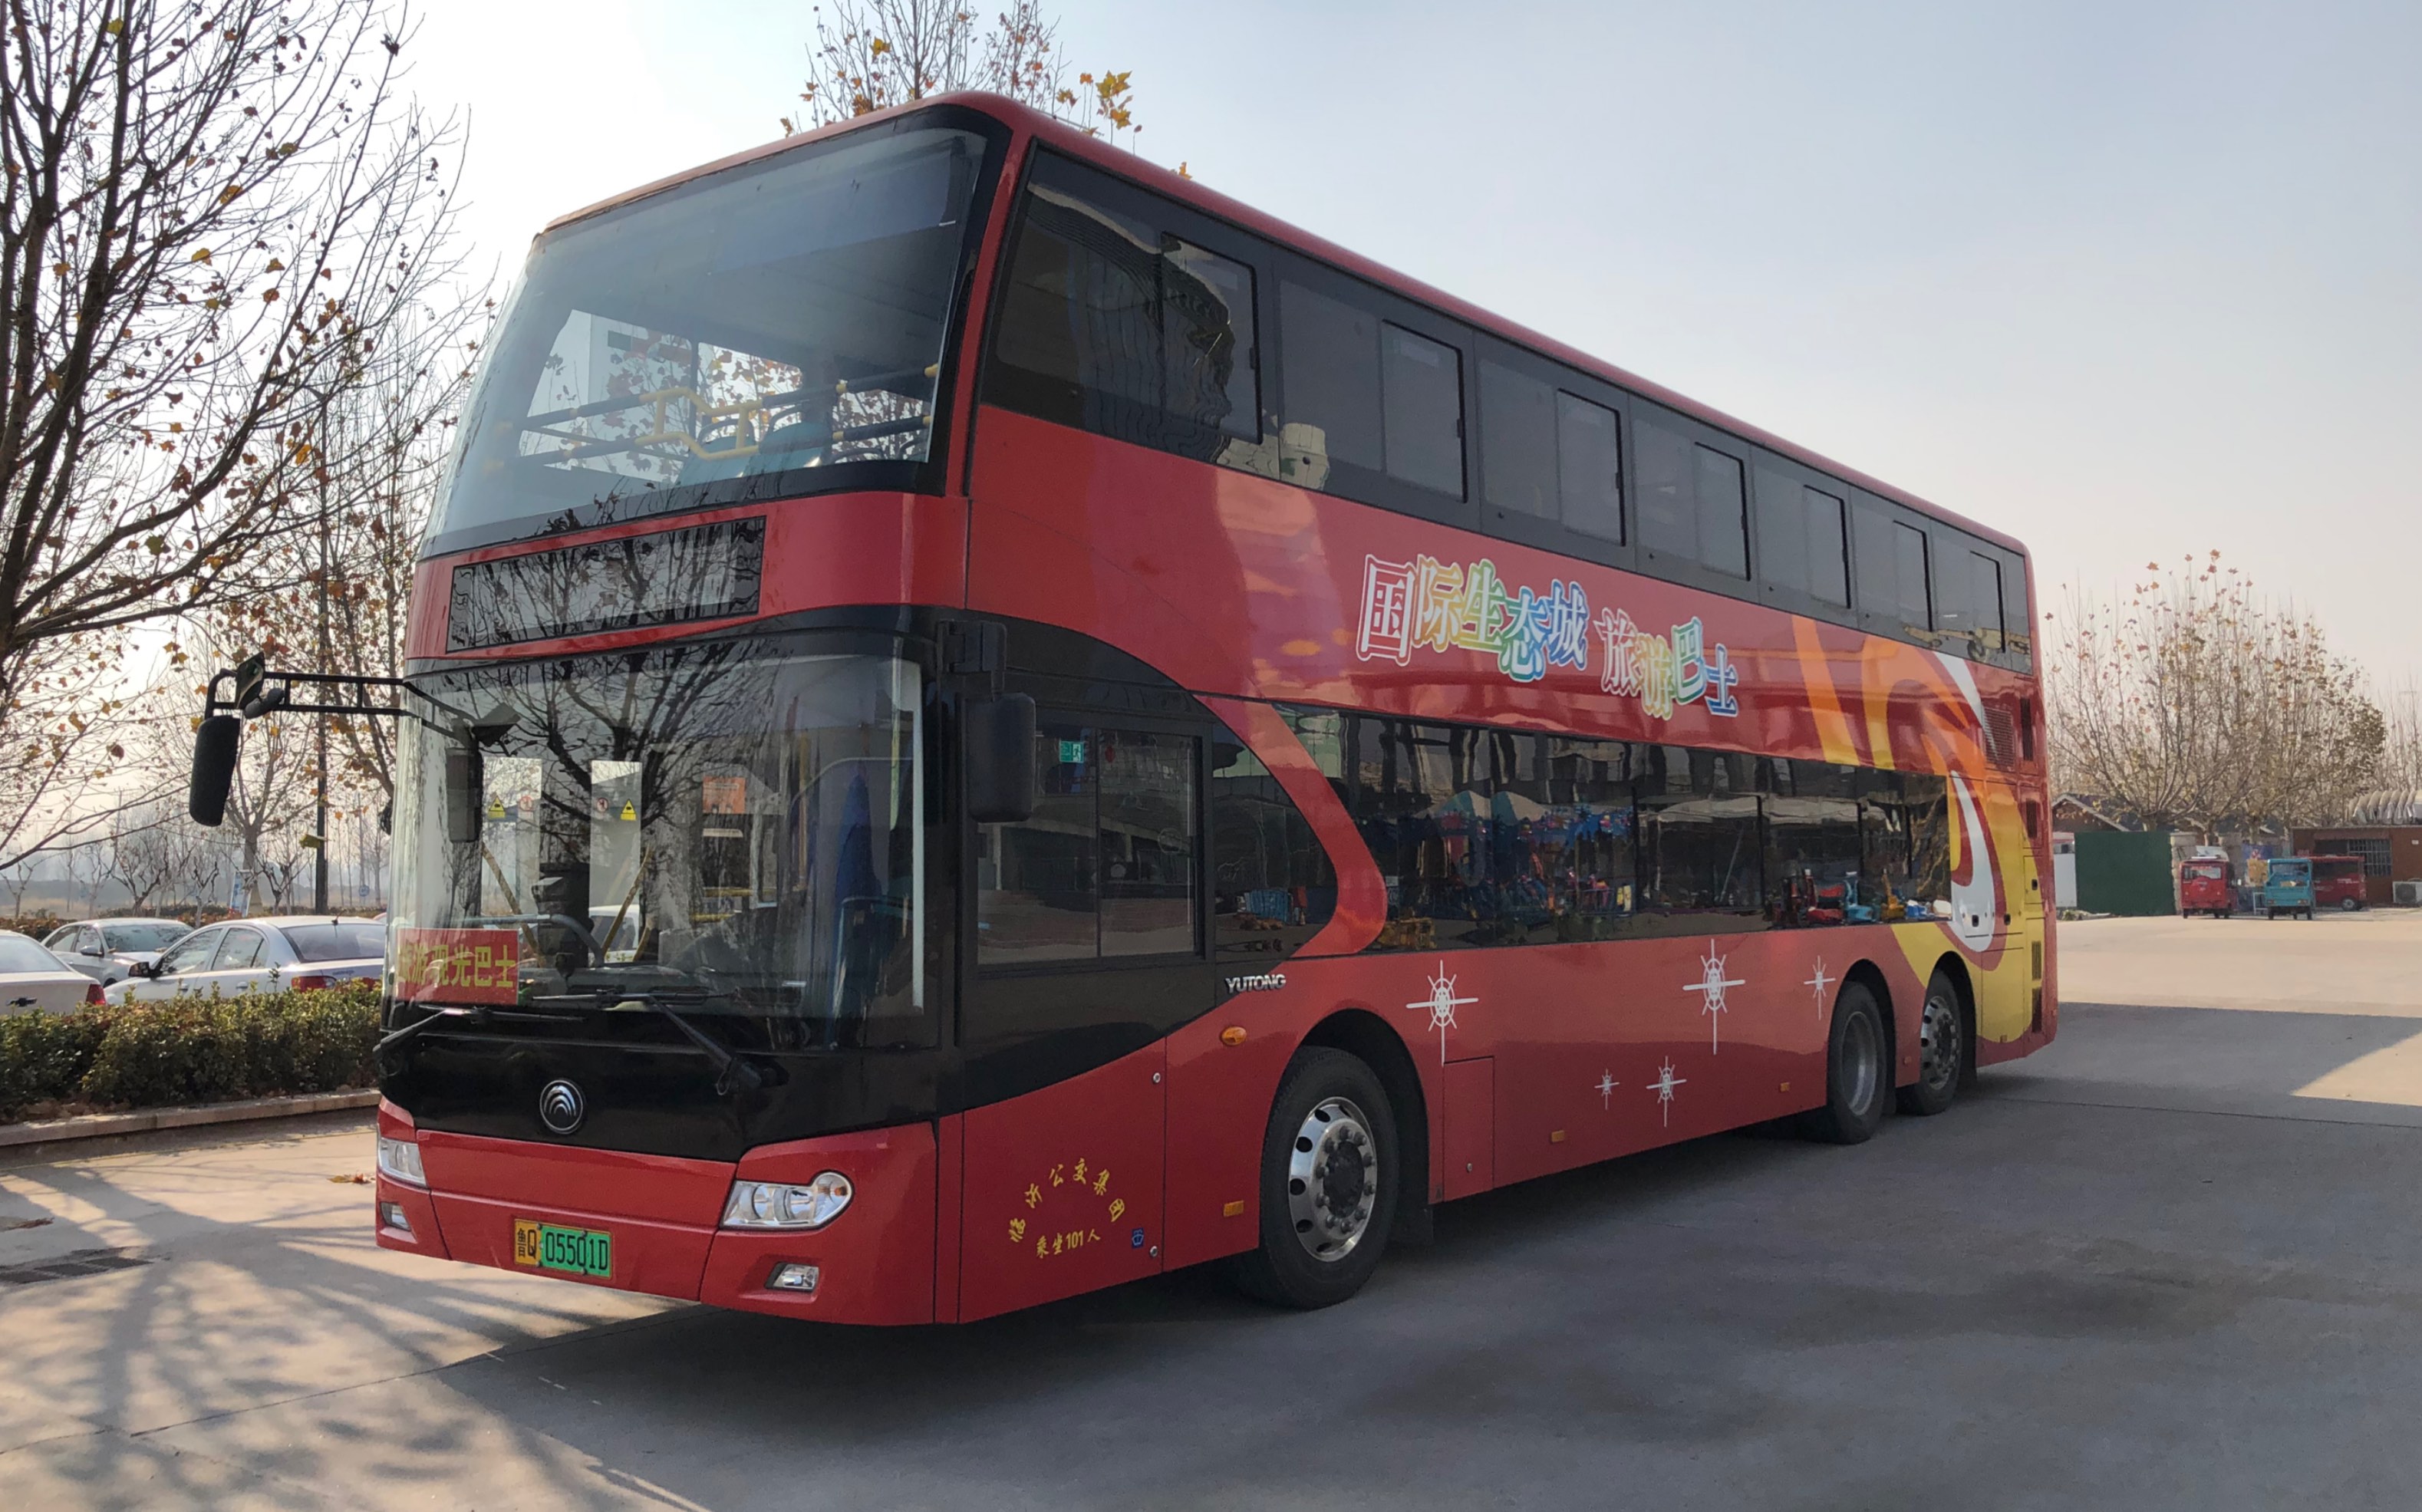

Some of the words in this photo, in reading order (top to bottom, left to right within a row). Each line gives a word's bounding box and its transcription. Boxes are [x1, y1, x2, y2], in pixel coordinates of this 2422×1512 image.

[1356, 553, 1590, 684] 国际生态城
[1593, 606, 1739, 721] 旅游巴士
[1225, 973, 1287, 993] YUTONG
